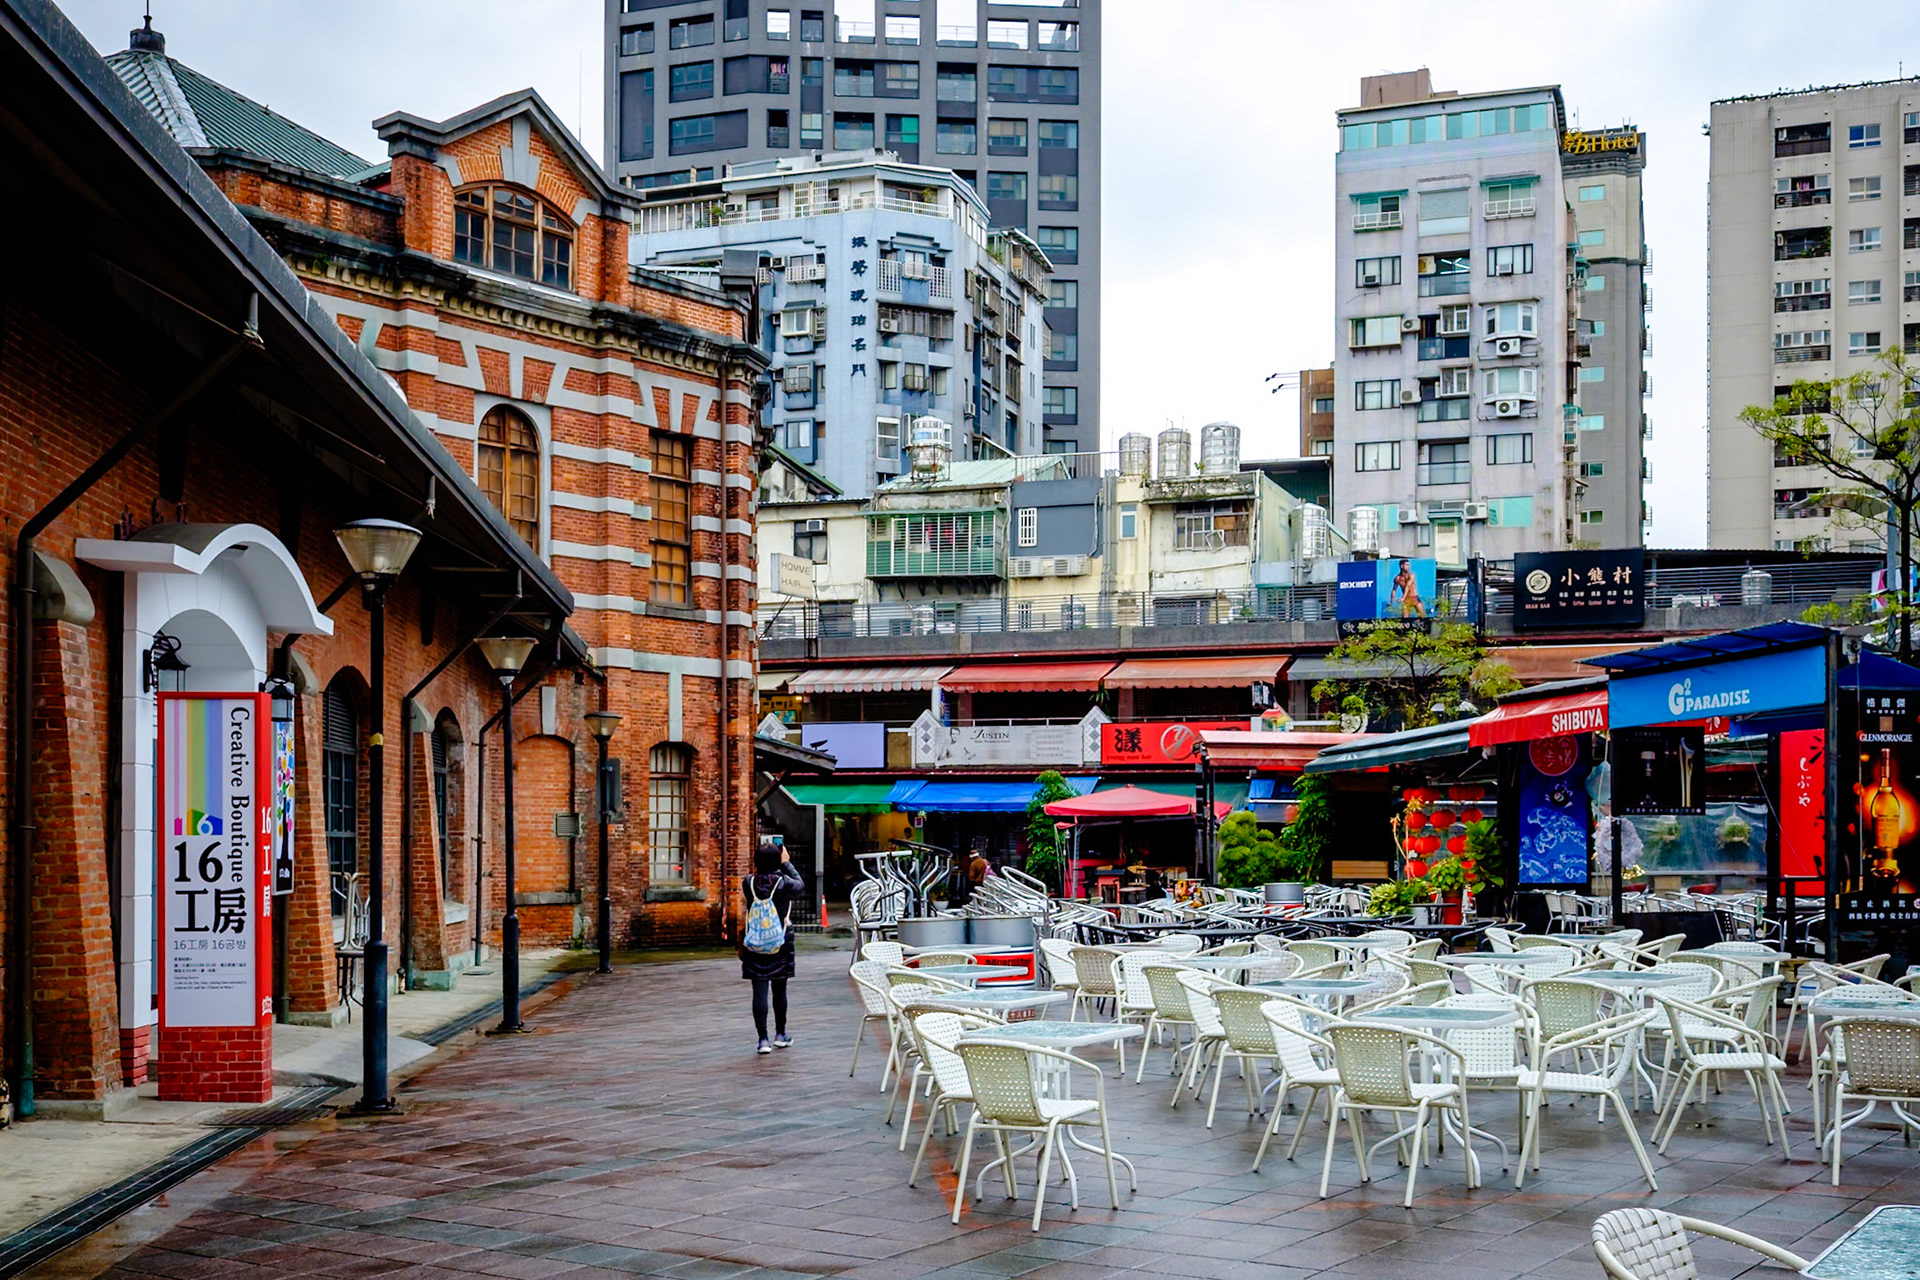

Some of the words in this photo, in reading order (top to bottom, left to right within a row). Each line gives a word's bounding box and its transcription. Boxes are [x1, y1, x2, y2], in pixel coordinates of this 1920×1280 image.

[1591, 131, 1638, 152] Hotel
[781, 577, 801, 588] HAIR
[1560, 566, 1632, 586] 小熊村
[1686, 689, 1750, 712] PARADISE
[1552, 707, 1604, 733] SHIBUYA
[230, 707, 250, 788] Creative
[1860, 733, 1913, 742] GLENMORANGIE
[227, 795, 250, 883] Boutique
[174, 841, 223, 883] 16
[174, 887, 247, 934] 工房
[1889, 912, 1920, 920] 安全有保
